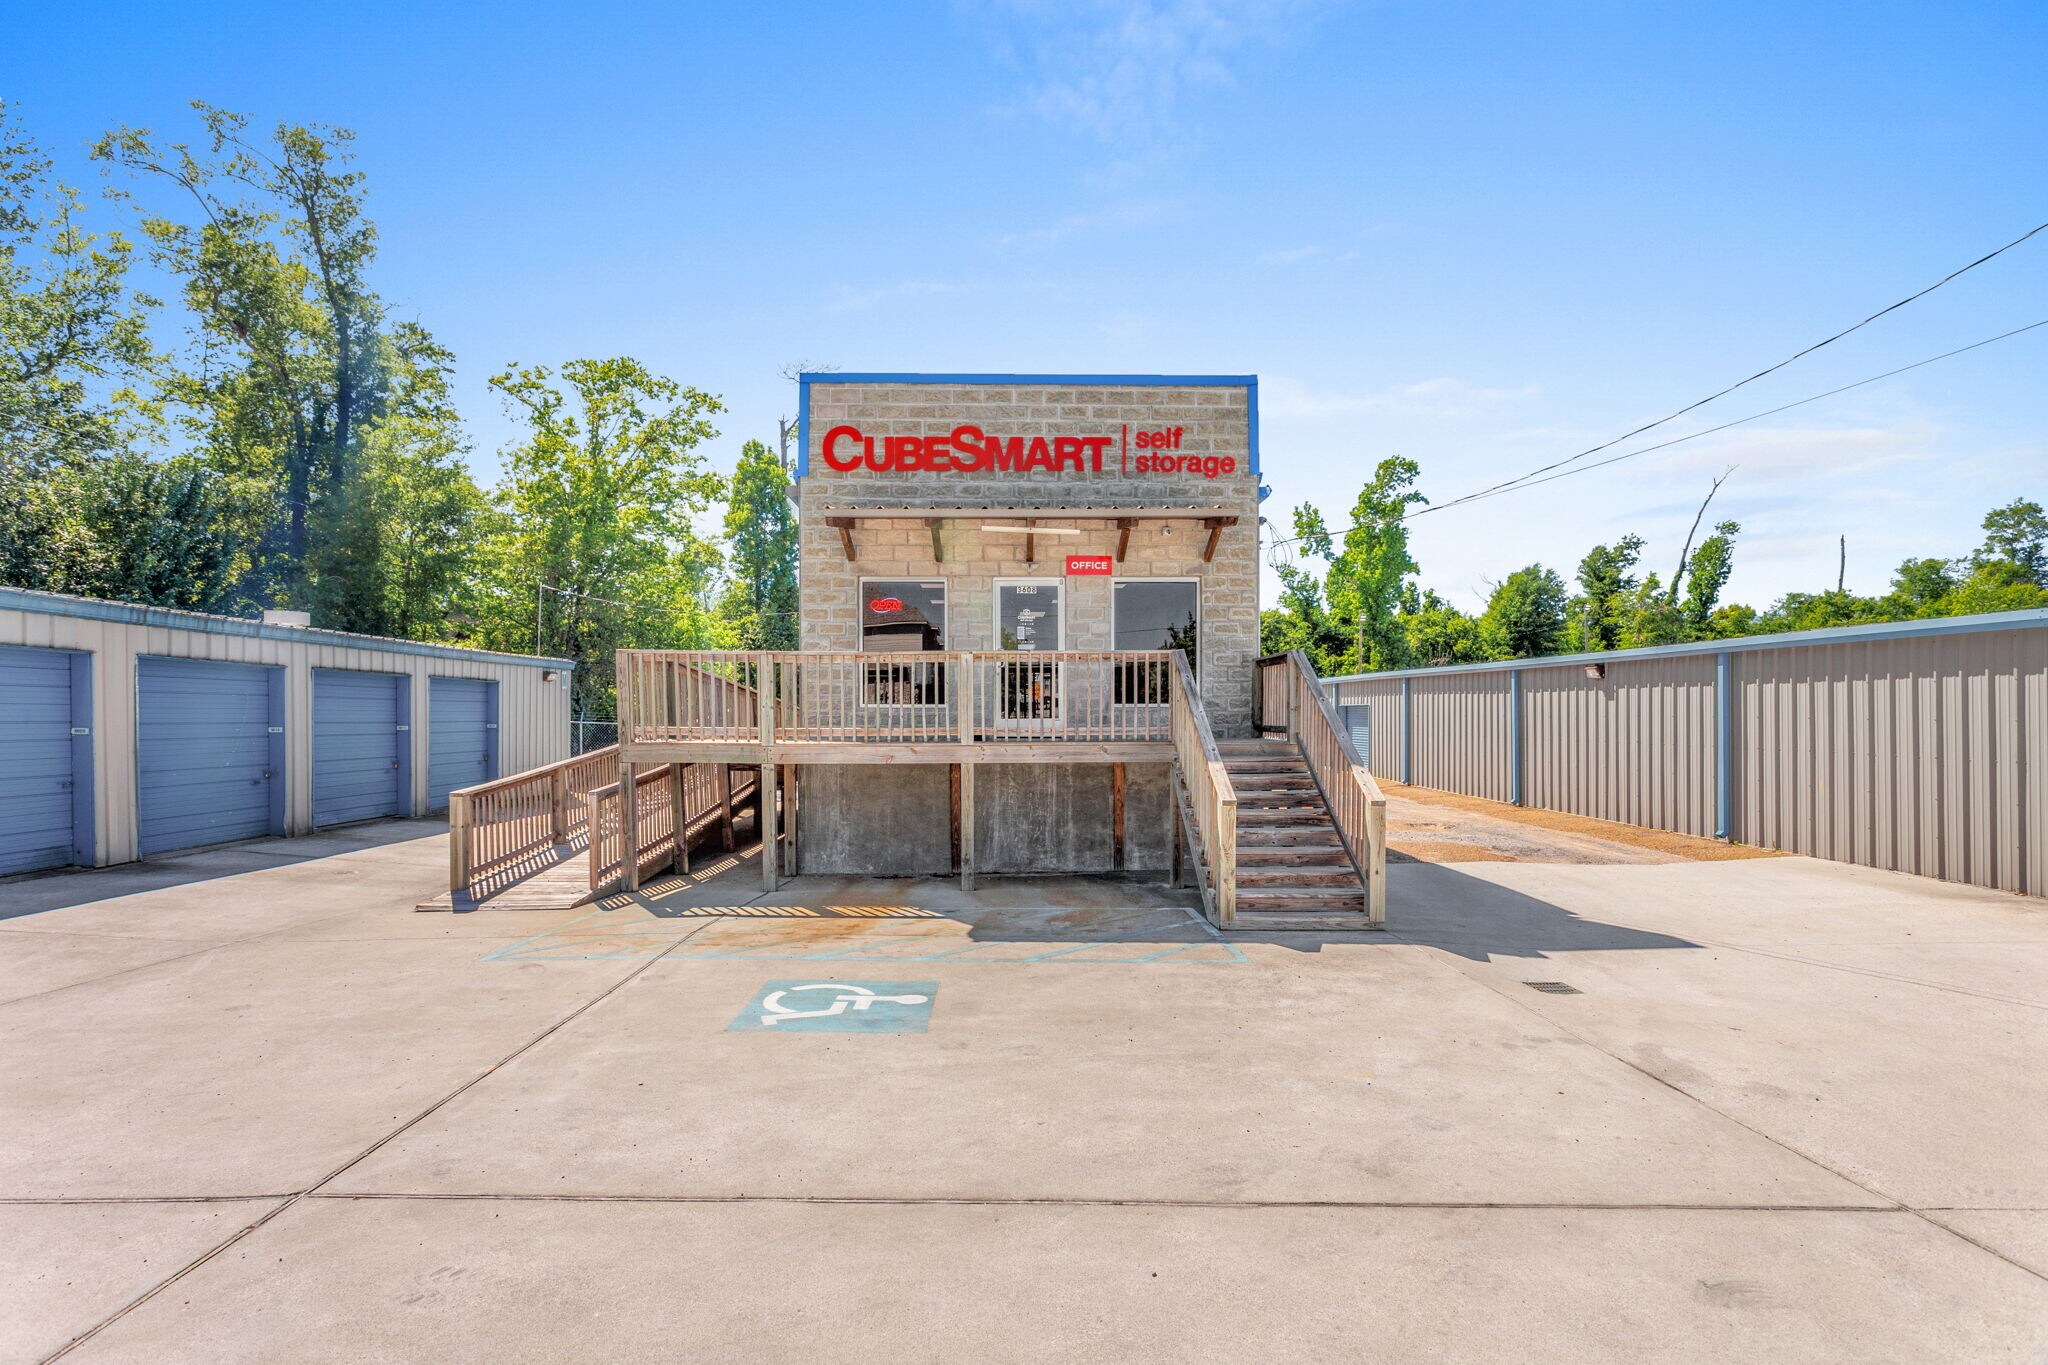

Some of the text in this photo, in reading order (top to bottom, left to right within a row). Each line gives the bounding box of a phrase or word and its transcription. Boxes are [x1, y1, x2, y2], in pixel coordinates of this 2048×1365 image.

[1135, 427, 1184, 449] self
[1135, 452, 1236, 478] storage
[1071, 561, 1108, 570] OFFICE
[870, 599, 902, 611] OPEN
